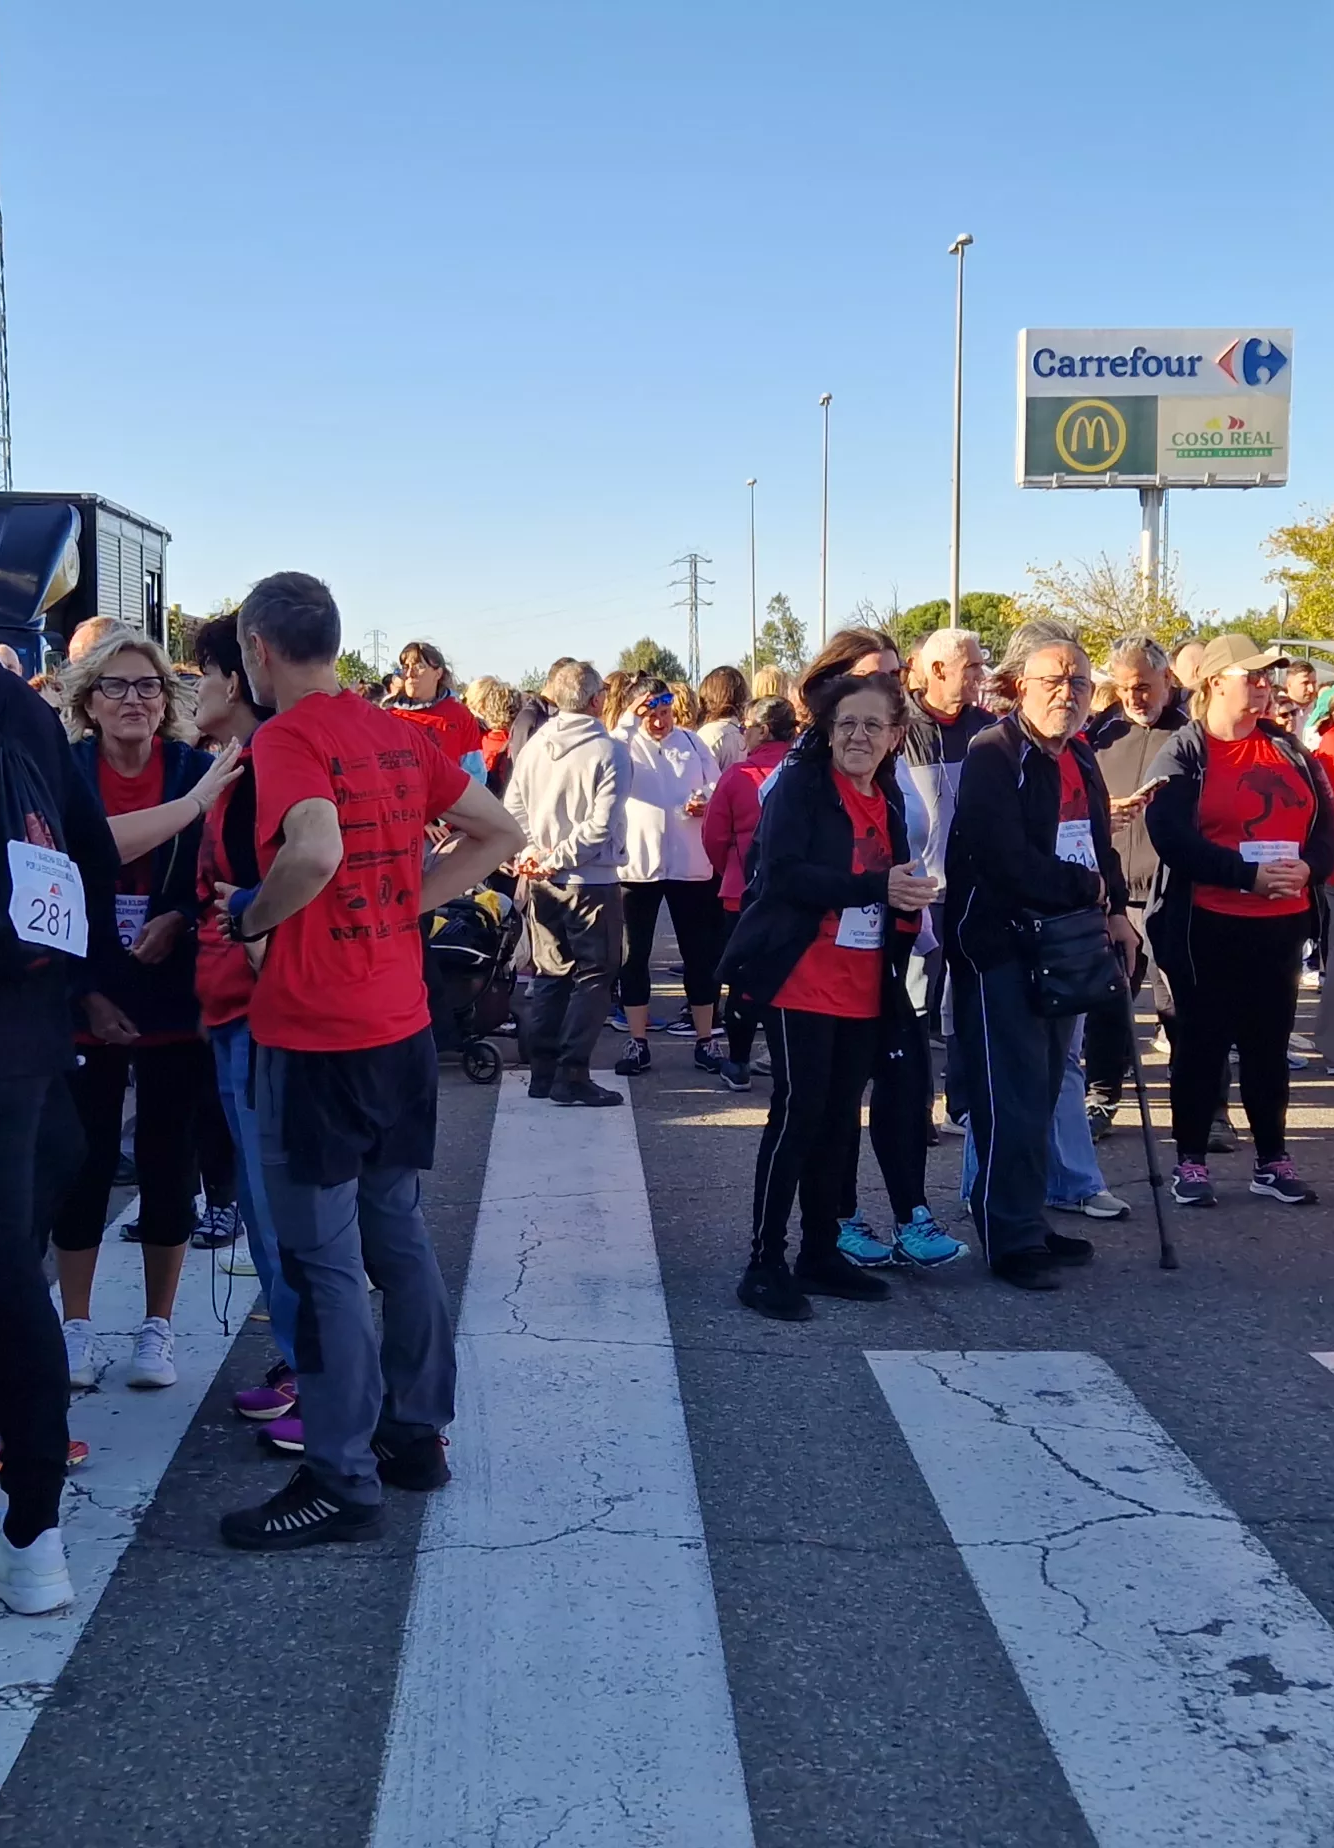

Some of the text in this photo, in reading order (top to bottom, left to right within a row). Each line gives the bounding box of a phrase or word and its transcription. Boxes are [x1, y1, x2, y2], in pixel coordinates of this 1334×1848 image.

[1033, 347, 1203, 378] Carrefour
[1172, 431, 1275, 446] COSO REAL
[28, 898, 71, 940] 281
